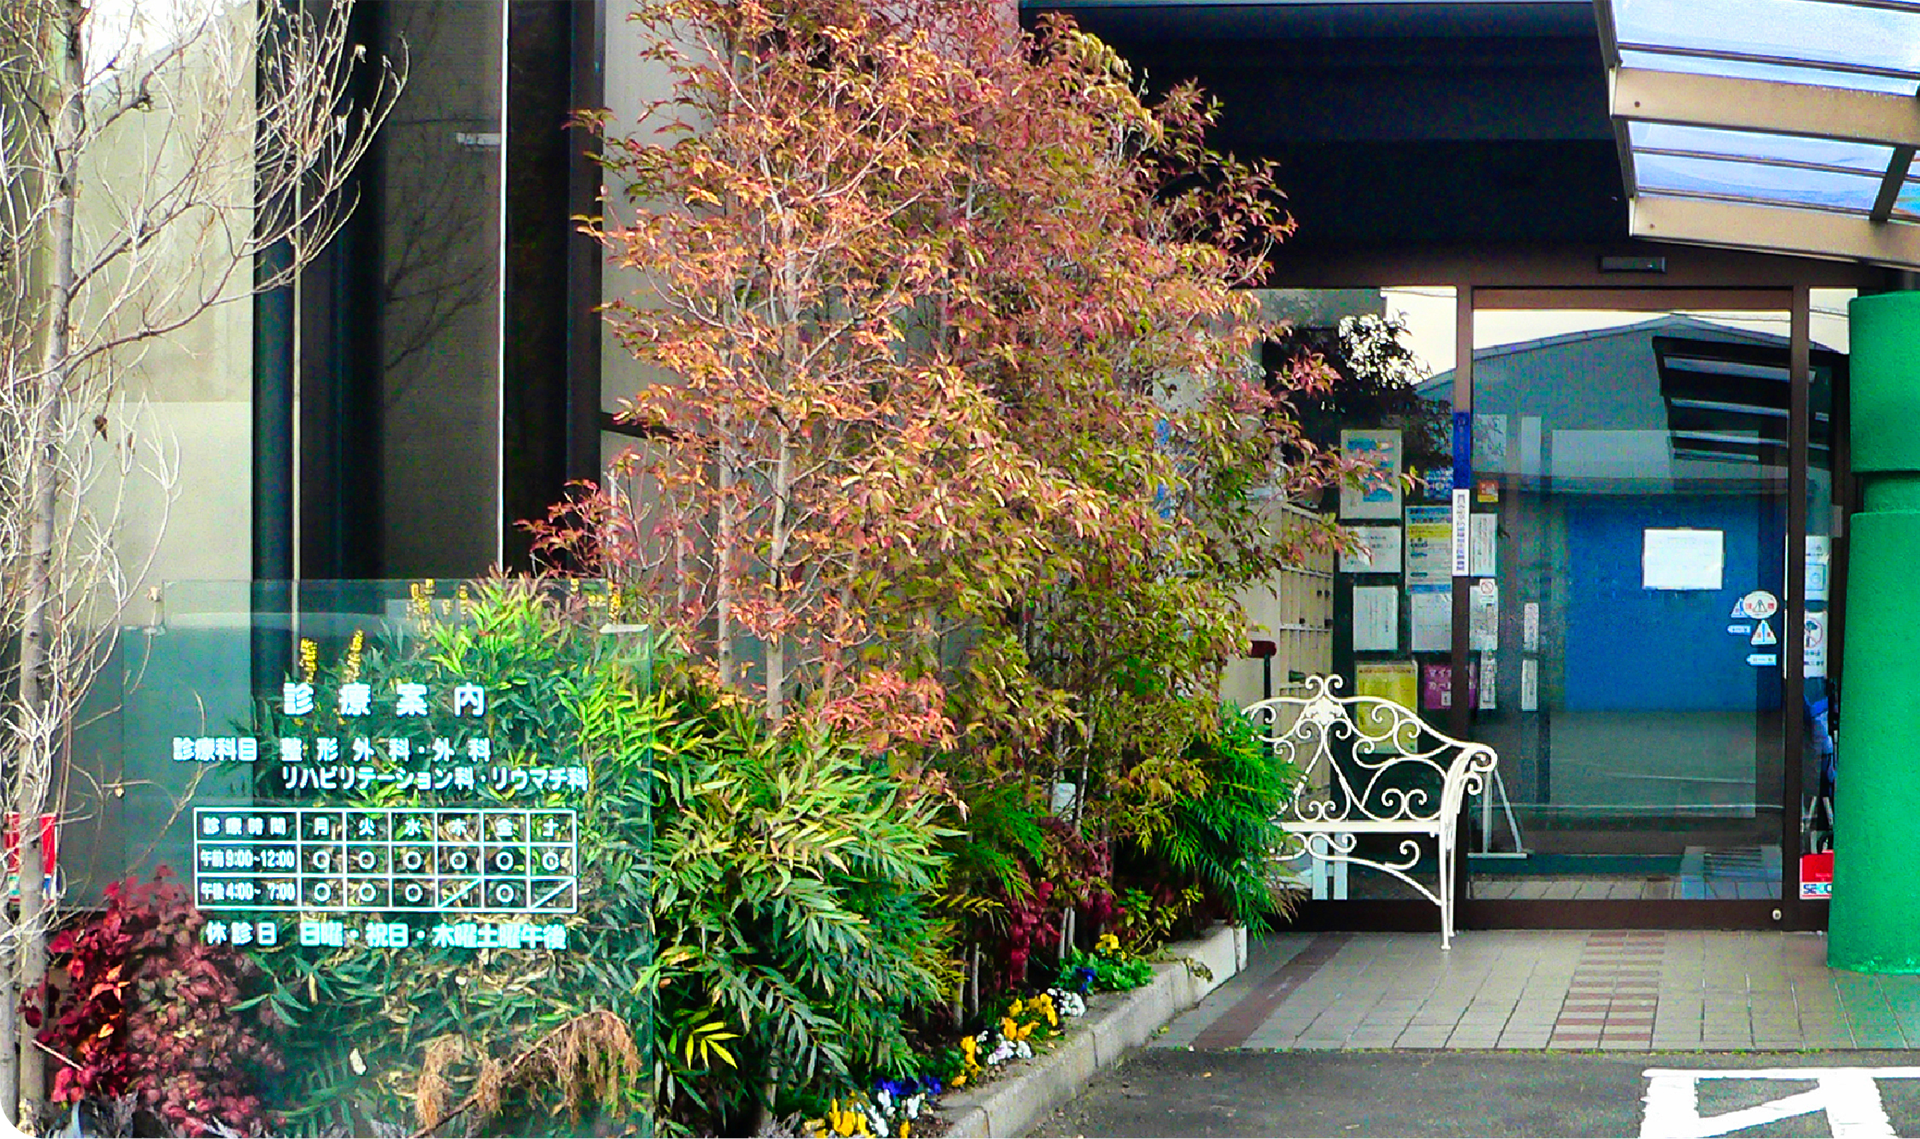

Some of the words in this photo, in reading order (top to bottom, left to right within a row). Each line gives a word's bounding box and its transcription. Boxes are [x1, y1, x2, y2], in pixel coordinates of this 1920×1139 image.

[283, 682, 485, 717] 診療案内
[172, 737, 258, 762] 診療科目
[203, 817, 287, 836] 診療時間
[314, 817, 330, 836] 月
[358, 817, 376, 837] 火
[404, 818, 422, 837] 水
[450, 818, 467, 837] 木
[496, 818, 513, 837] 金
[542, 818, 559, 837] 土
[206, 920, 277, 946] 休診日
